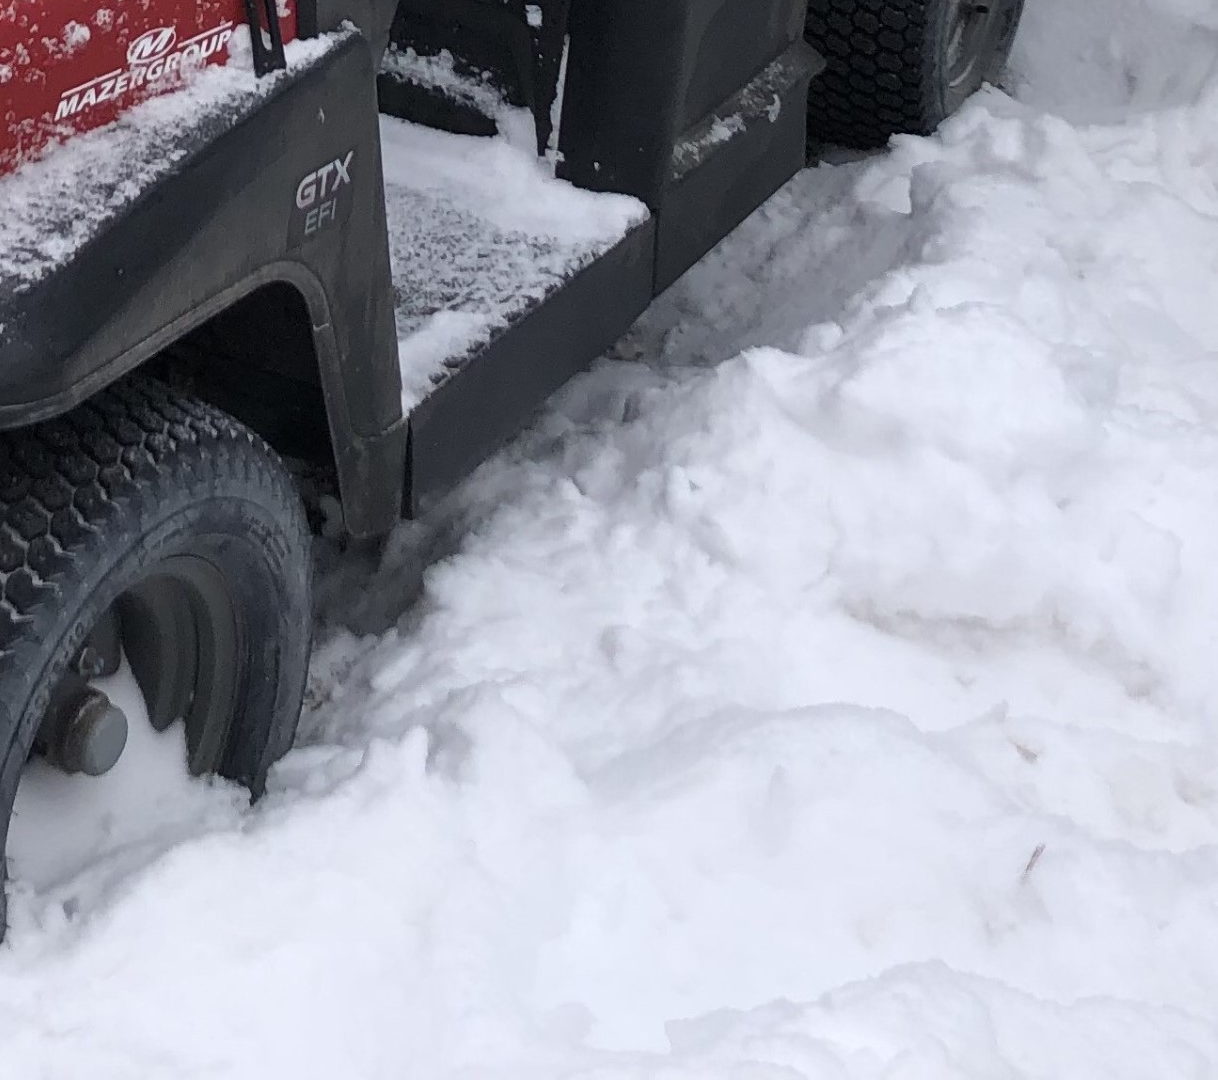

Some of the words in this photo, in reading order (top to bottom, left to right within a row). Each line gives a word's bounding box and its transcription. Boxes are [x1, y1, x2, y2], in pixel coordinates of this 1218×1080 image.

[54, 28, 233, 122] MAZERGROUP
[295, 149, 354, 210] GTX
[304, 197, 337, 236] EFI
